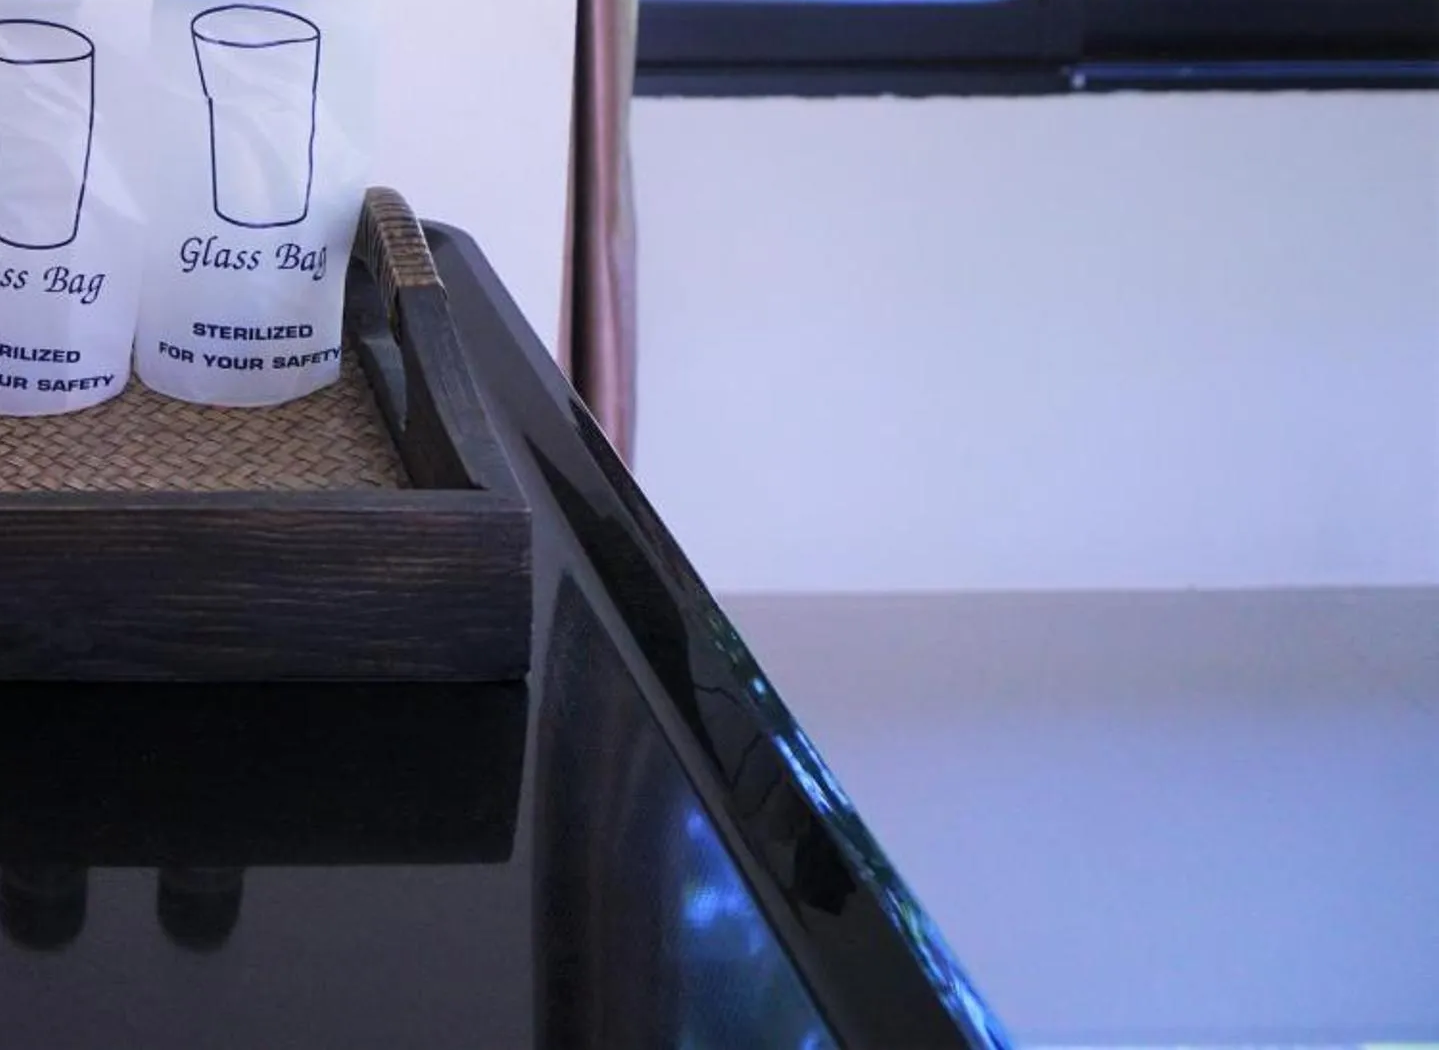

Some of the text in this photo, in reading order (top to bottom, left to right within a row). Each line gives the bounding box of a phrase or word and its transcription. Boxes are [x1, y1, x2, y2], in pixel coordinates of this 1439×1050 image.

[180, 235, 328, 281] Glass Bag
[43, 266, 106, 305] Bag
[193, 322, 313, 341] STERILIZED
[159, 341, 342, 370] FOR YOUR SAFETY
[37, 374, 115, 393] SAFETY
